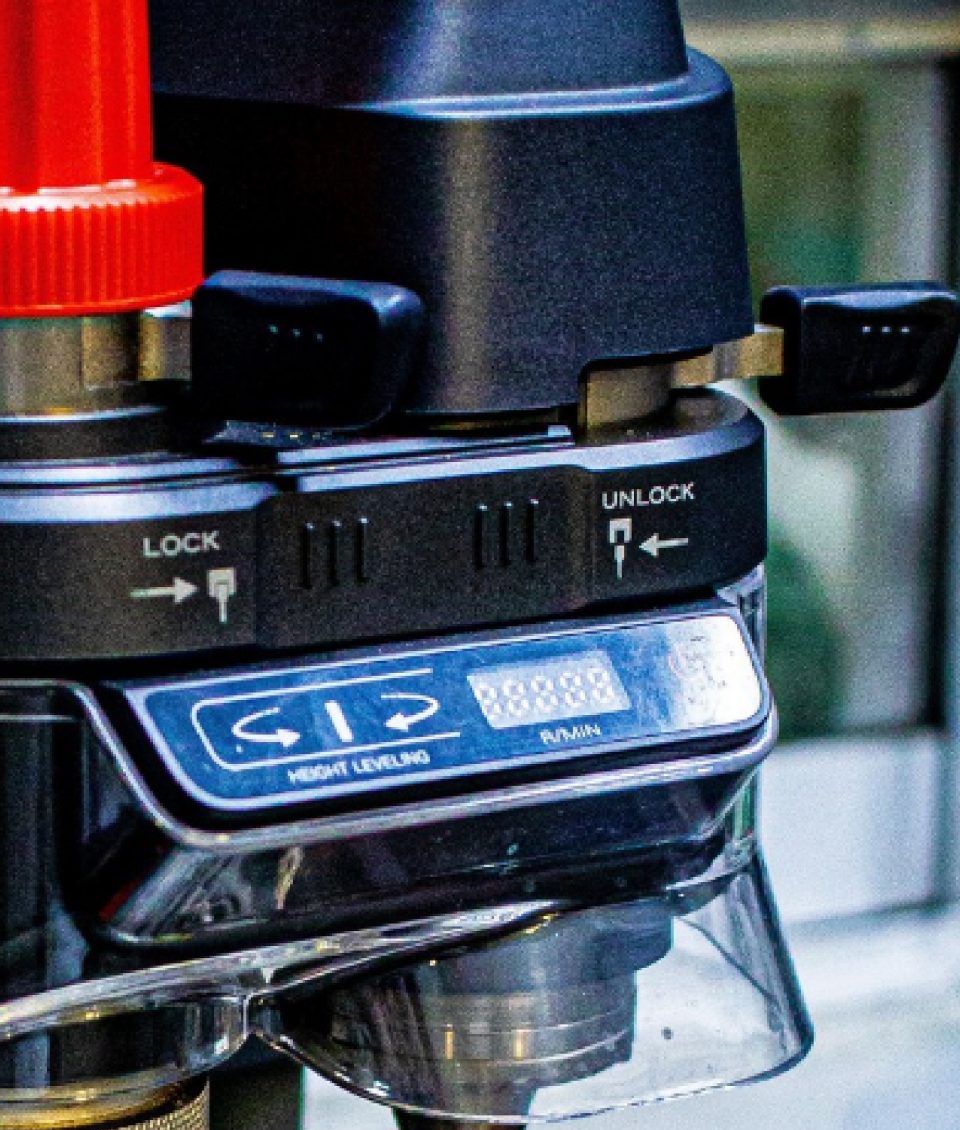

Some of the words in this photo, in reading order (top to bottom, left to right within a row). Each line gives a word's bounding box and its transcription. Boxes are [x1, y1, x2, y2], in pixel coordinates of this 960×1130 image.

[601, 481, 695, 510] UNLOCK
[142, 530, 221, 559] LOCK
[287, 760, 349, 785] HEIGHT
[351, 748, 431, 775] LEVELING
